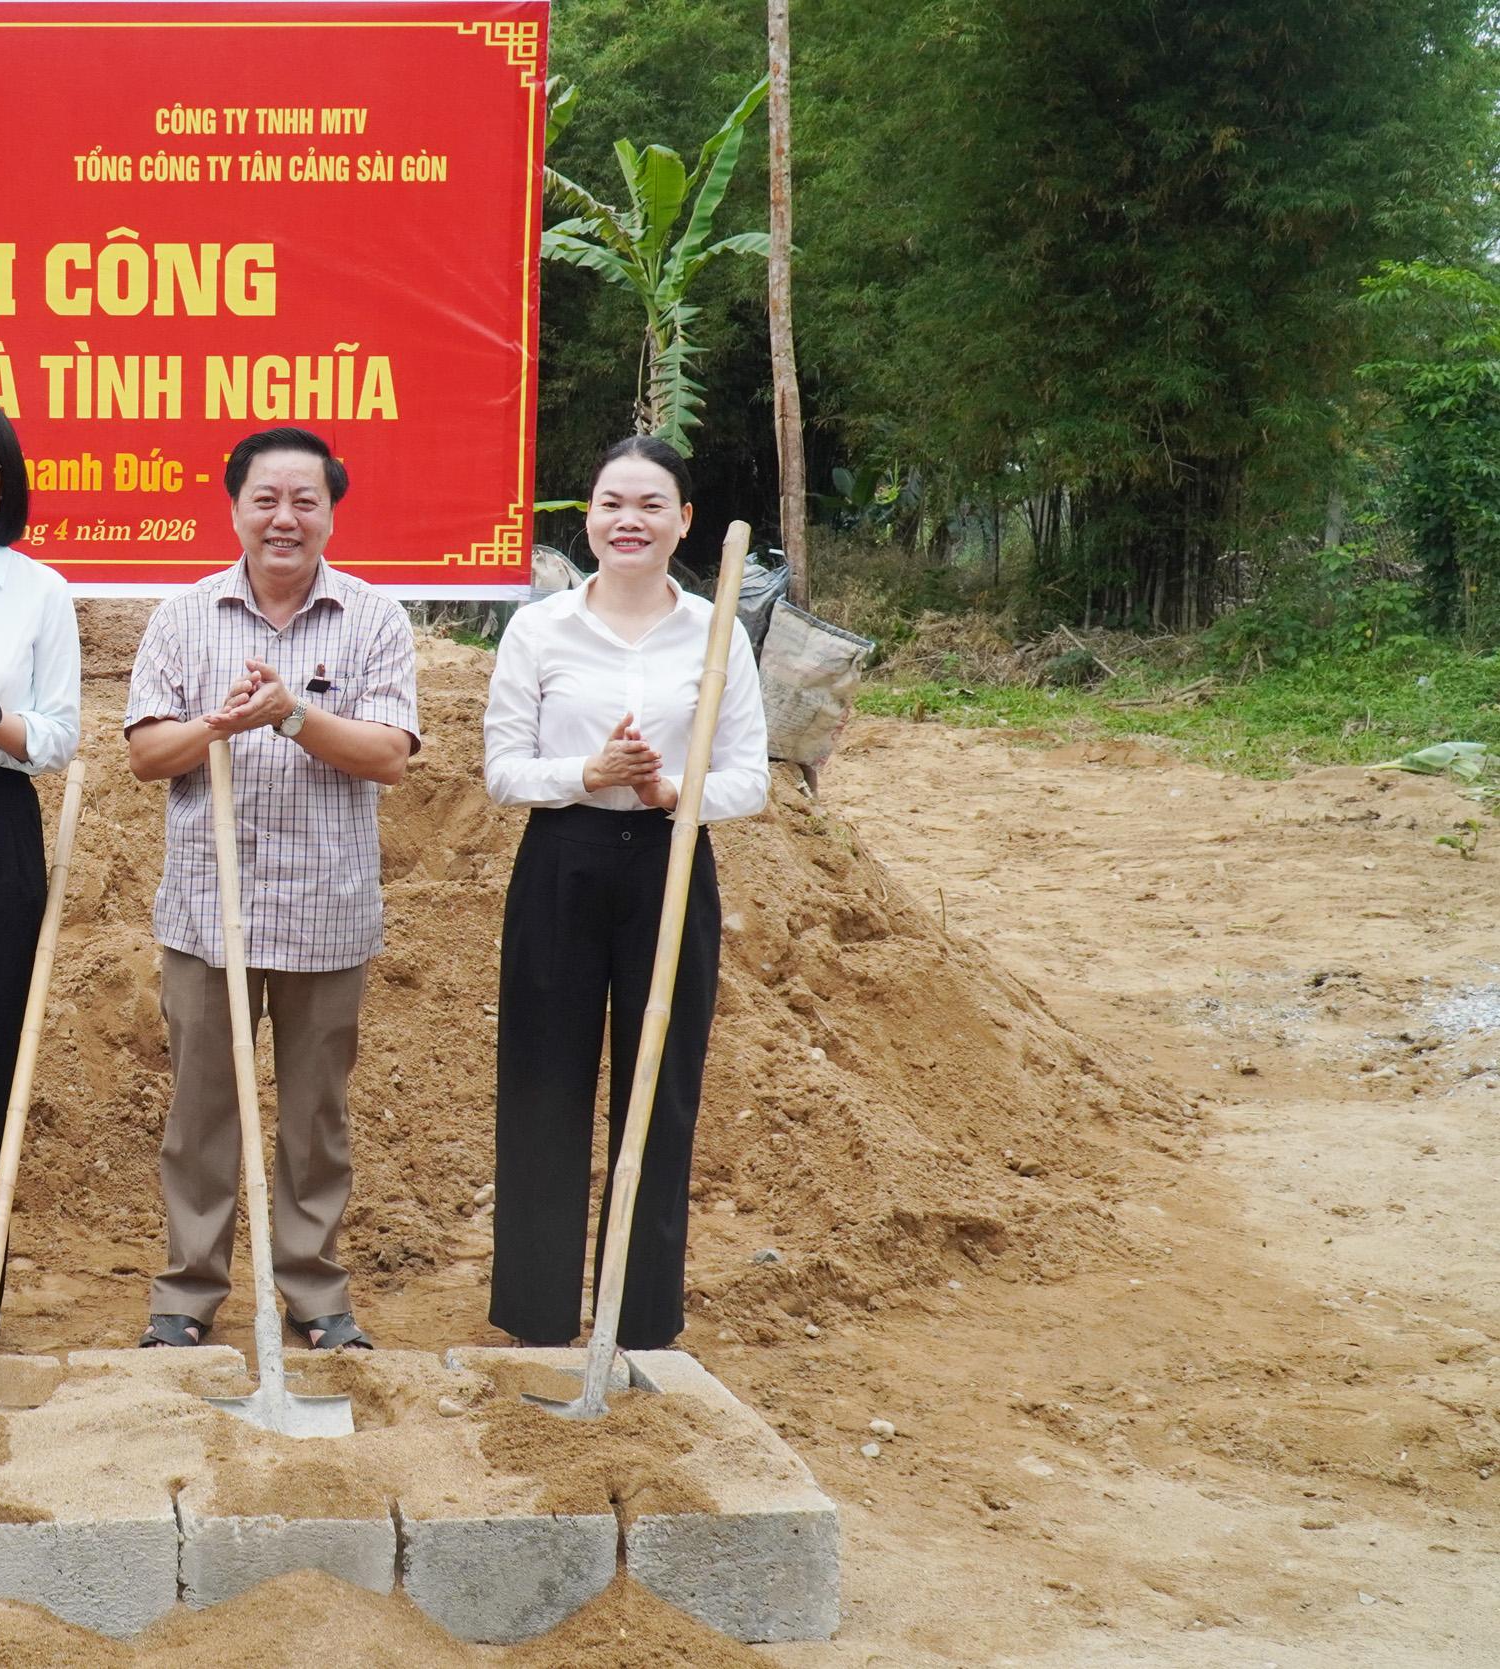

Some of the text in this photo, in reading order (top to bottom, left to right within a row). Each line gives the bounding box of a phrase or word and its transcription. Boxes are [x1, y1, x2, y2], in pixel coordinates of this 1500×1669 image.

[155, 103, 368, 135] CÔNG TY TNHH MTV
[73, 145, 447, 182] TỔNG CÔNG TY TÂN CẢNG SÀI GÒN
[45, 226, 277, 317] CÔNG
[39, 340, 183, 420] TÌNH
[205, 342, 399, 421] NGHĨA
[113, 447, 183, 493] Đức
[53, 517, 68, 542] 4
[74, 519, 131, 542] năm
[137, 518, 197, 543] 2026
